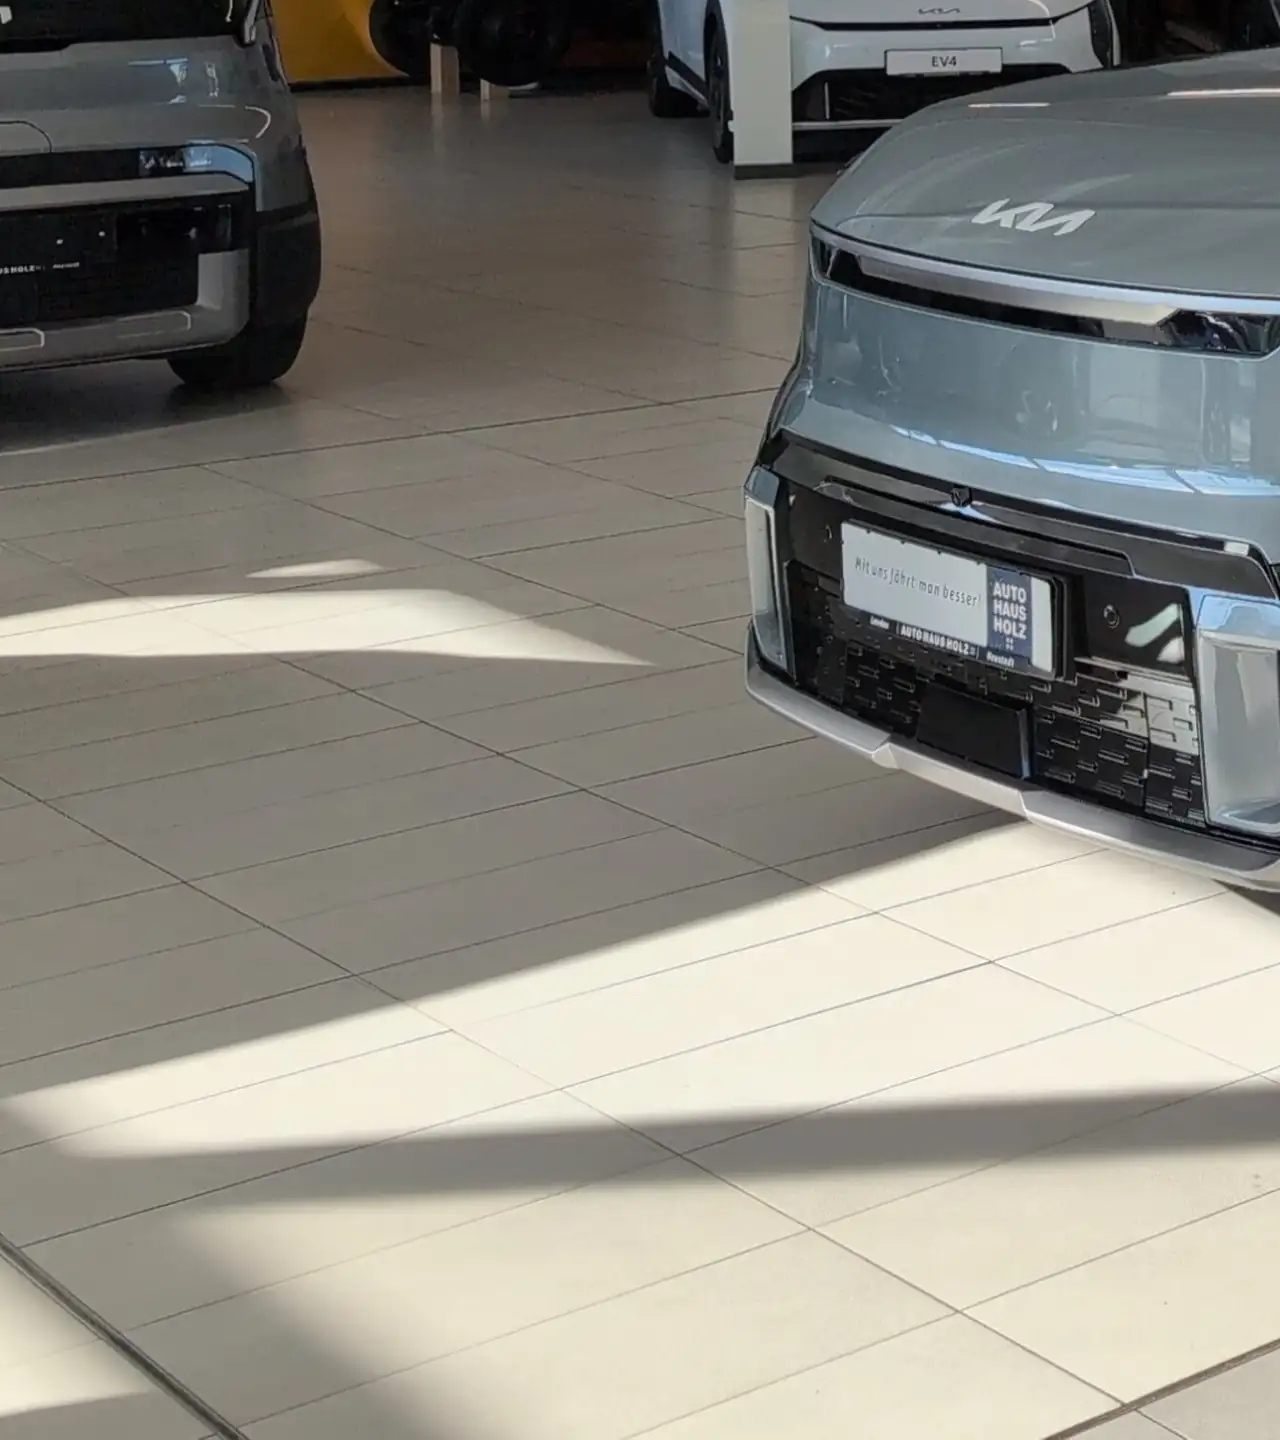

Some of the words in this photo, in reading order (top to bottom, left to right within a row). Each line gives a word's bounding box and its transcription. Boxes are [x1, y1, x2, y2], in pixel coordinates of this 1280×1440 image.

[931, 55, 957, 67] EV4
[855, 556, 871, 575] Mit
[918, 580, 941, 597] man
[993, 581, 1026, 603] AUTO
[993, 598, 1026, 621] HAUS
[993, 617, 1027, 640] HOLZ
